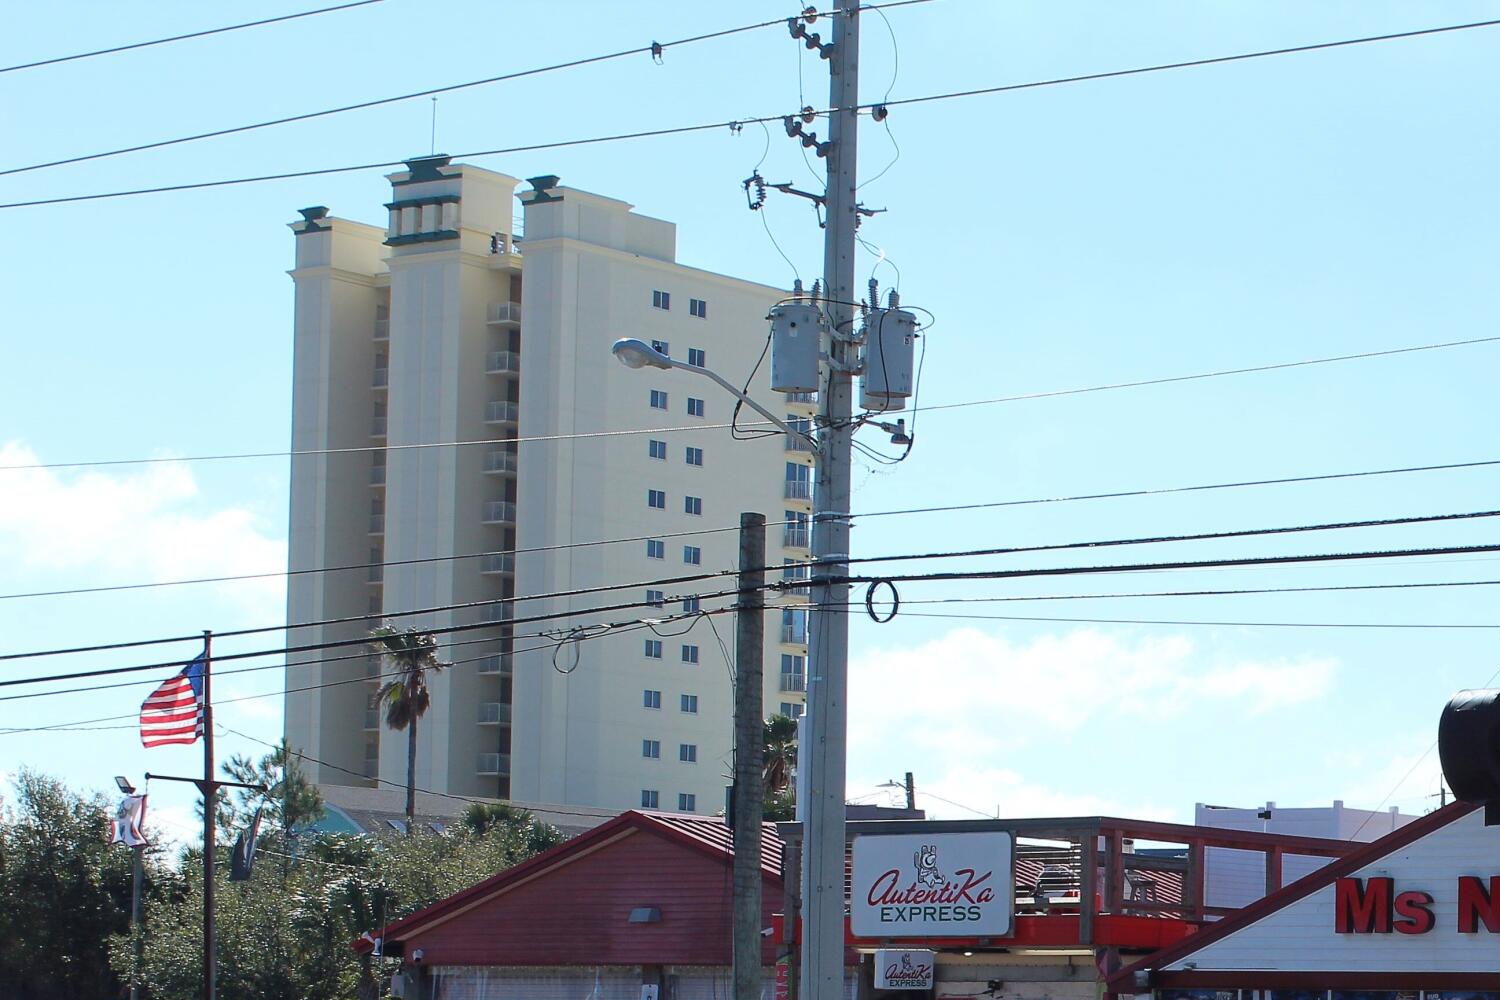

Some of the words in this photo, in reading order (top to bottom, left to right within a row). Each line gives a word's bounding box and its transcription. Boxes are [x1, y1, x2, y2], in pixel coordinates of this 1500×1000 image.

[867, 868, 996, 906] AutentiKa
[880, 906, 981, 922] EXPRESS
[1335, 876, 1435, 934] Ms
[889, 979, 927, 987] EXPRESS
